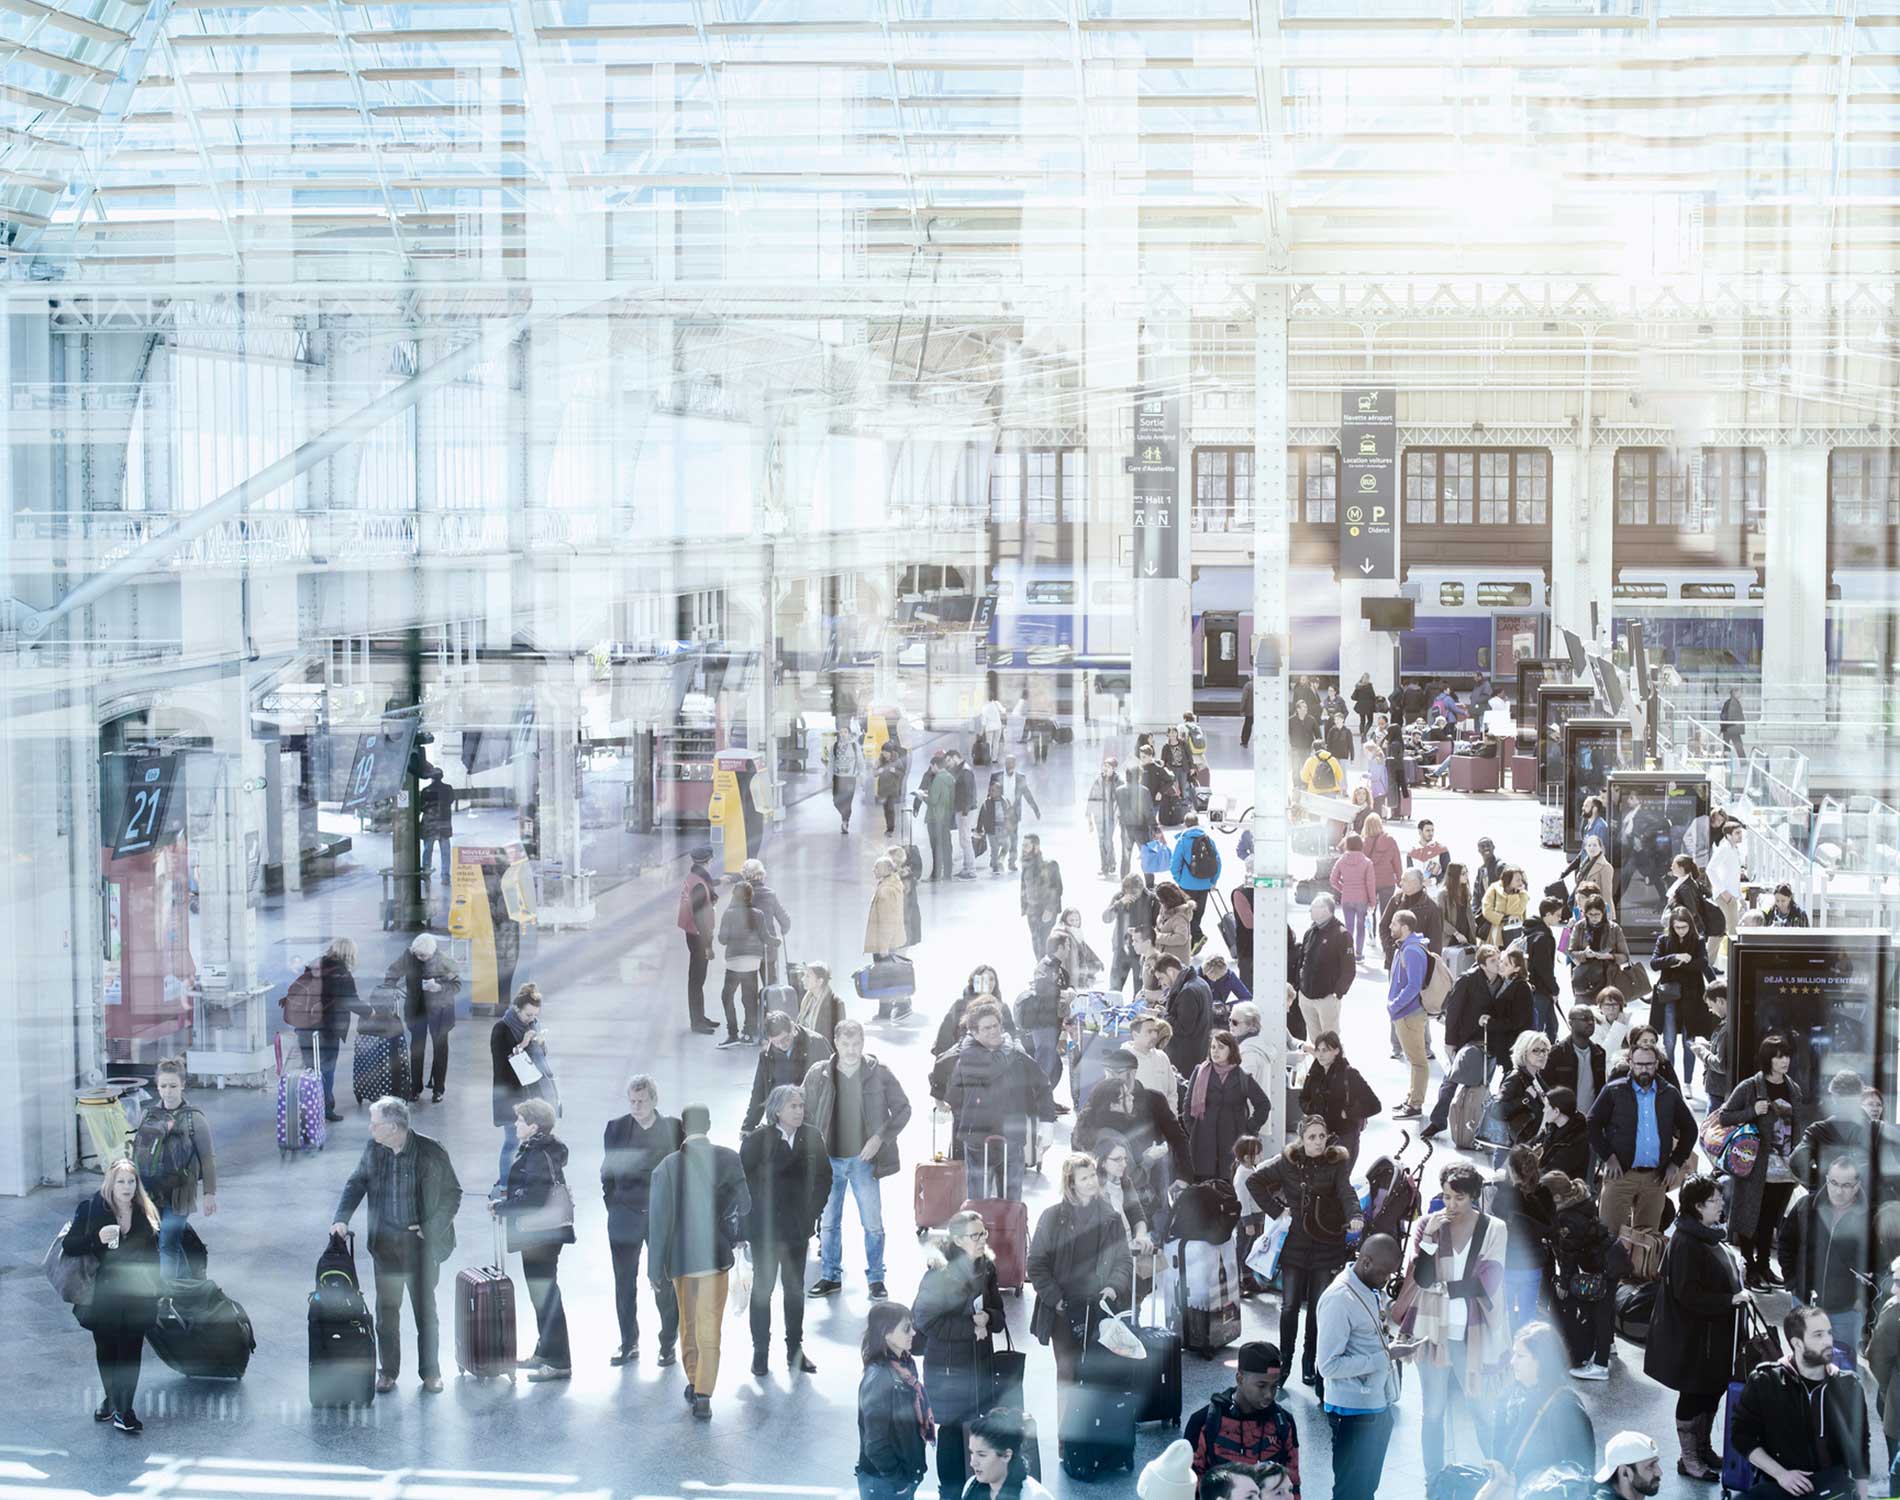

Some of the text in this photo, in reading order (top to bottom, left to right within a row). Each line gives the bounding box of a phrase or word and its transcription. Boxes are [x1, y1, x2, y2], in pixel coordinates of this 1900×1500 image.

[1140, 417, 1165, 427] Sortie
[1368, 414, 1393, 422] aéroport
[1145, 495, 1164, 504] Hall
[1166, 495, 1171, 504] 1
[1135, 514, 1168, 525] A N
[1373, 506, 1385, 522] P
[980, 606, 989, 624] 5
[354, 753, 375, 795] 19
[125, 787, 161, 839] 21
